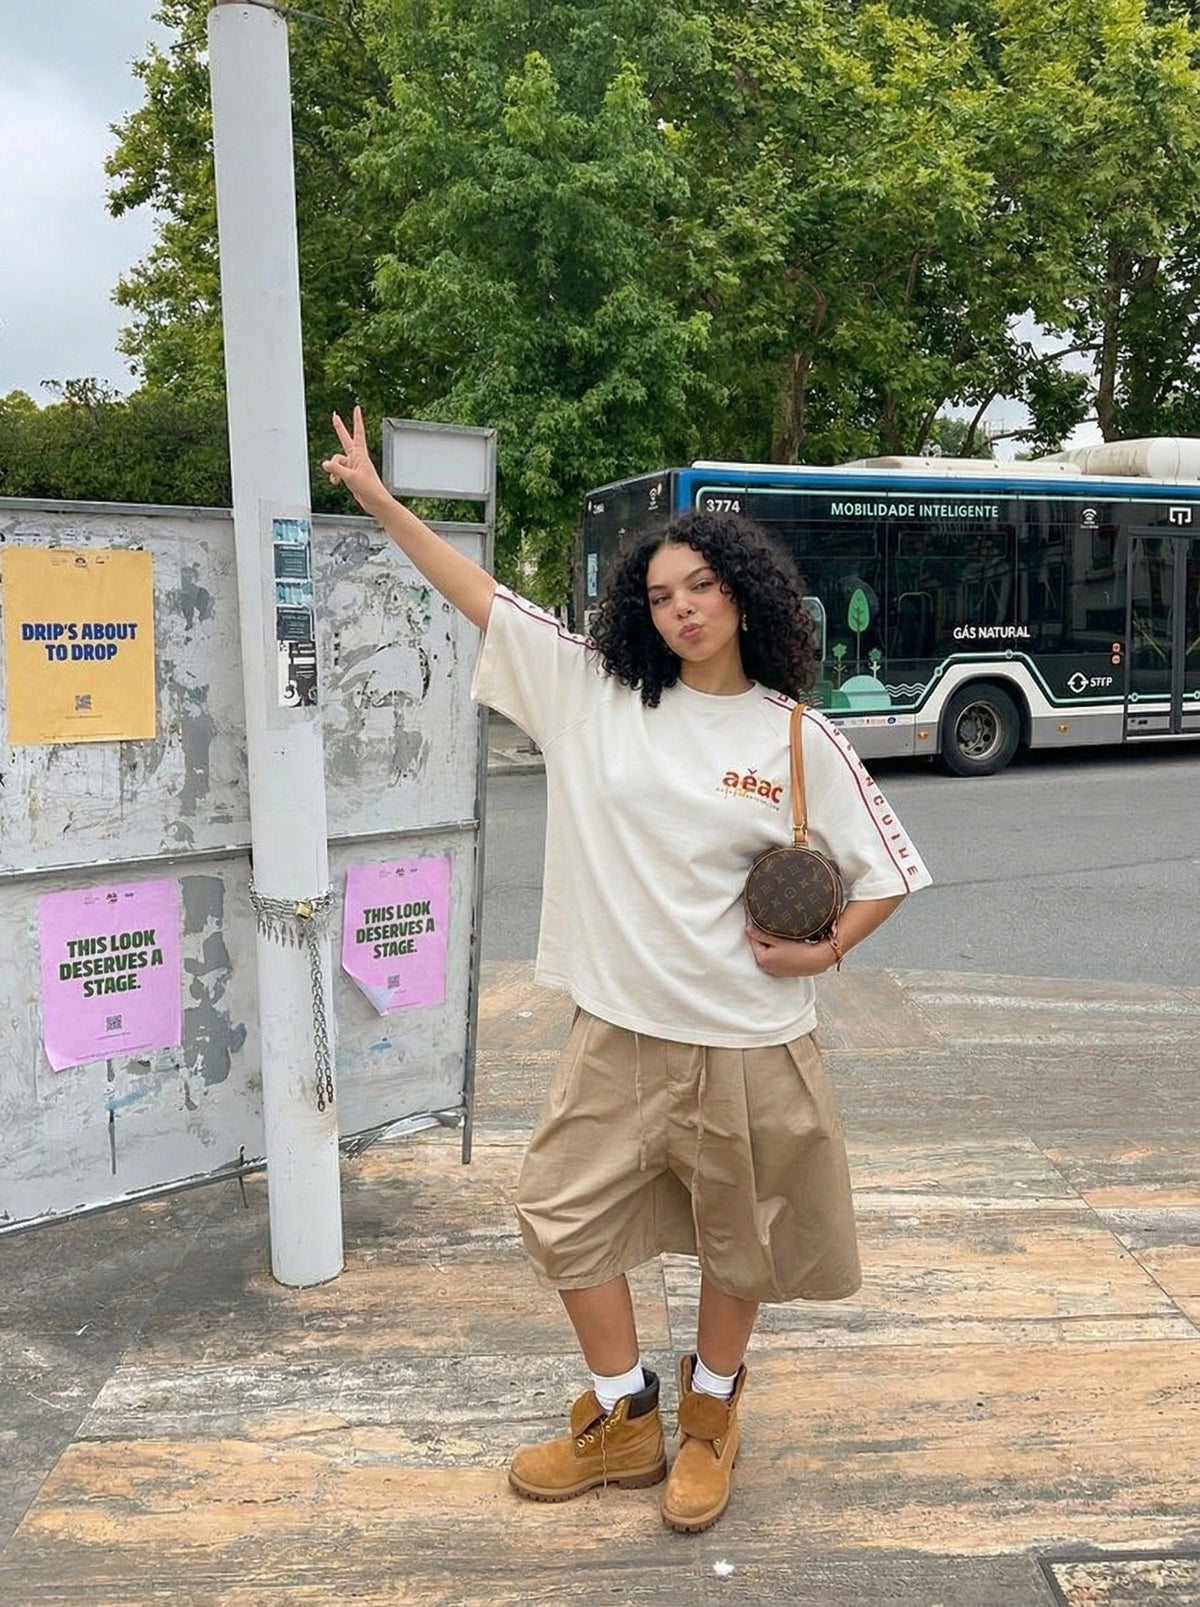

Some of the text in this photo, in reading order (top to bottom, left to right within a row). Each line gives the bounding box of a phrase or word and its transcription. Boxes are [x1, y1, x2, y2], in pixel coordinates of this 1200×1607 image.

[706, 499, 741, 513] 3774
[831, 502, 999, 518] MOBILIDADE INTELIGENTE
[22, 623, 138, 641] DRIP'S ABOUT
[953, 624, 1031, 639] GÁS NATURAL
[45, 643, 118, 661] TO DROP
[363, 900, 431, 925] THIS LOOK
[356, 917, 435, 944] DESERVES A
[67, 929, 156, 958] THIS LOOK
[373, 939, 418, 959] STAGE.
[59, 948, 164, 981] DESERVES A
[83, 973, 141, 998] STAGE.
